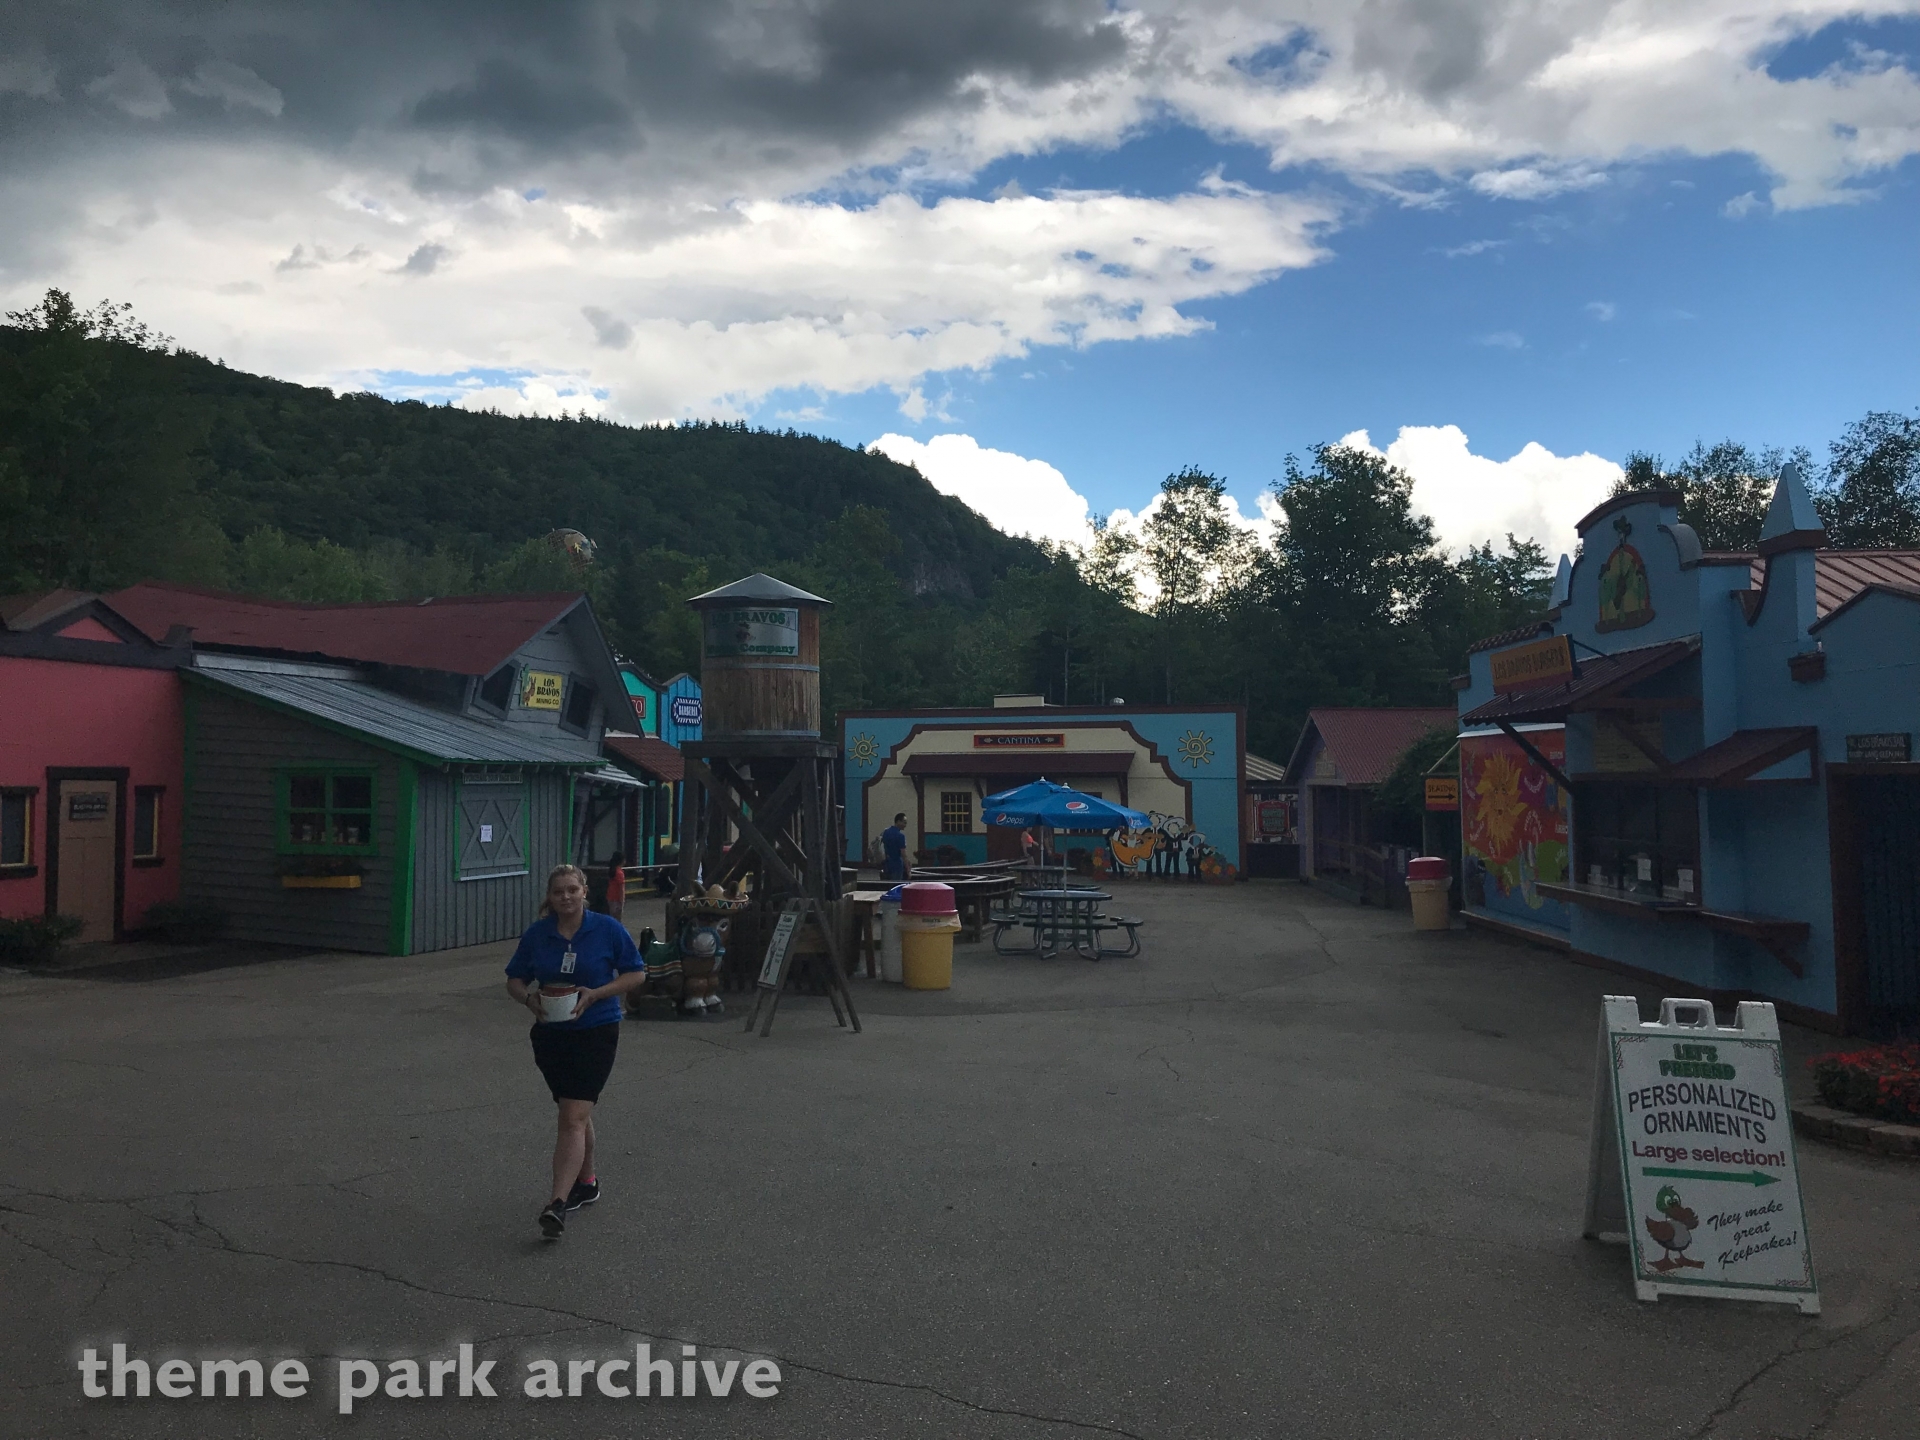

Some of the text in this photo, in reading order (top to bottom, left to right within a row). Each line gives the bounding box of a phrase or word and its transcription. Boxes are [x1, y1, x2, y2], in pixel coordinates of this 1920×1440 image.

[733, 611, 786, 625] BRAVOS
[739, 643, 795, 654] Company
[536, 686, 560, 698] BRAVOS
[543, 678, 555, 688] LOS
[997, 736, 1041, 745] CANTINA
[1428, 784, 1456, 793] SEATING
[1006, 815, 1025, 826] pepsi
[1672, 1043, 1718, 1062] LET'S
[1659, 1060, 1736, 1080] PRETEND
[1628, 1082, 1776, 1121] PERSONALIZED
[1644, 1110, 1766, 1144] ORNAMENTS
[1632, 1141, 1786, 1167] Large selection!
[1707, 1200, 1784, 1231] They make
[1733, 1221, 1771, 1245] great
[1718, 1231, 1797, 1270] Keepsakes!
